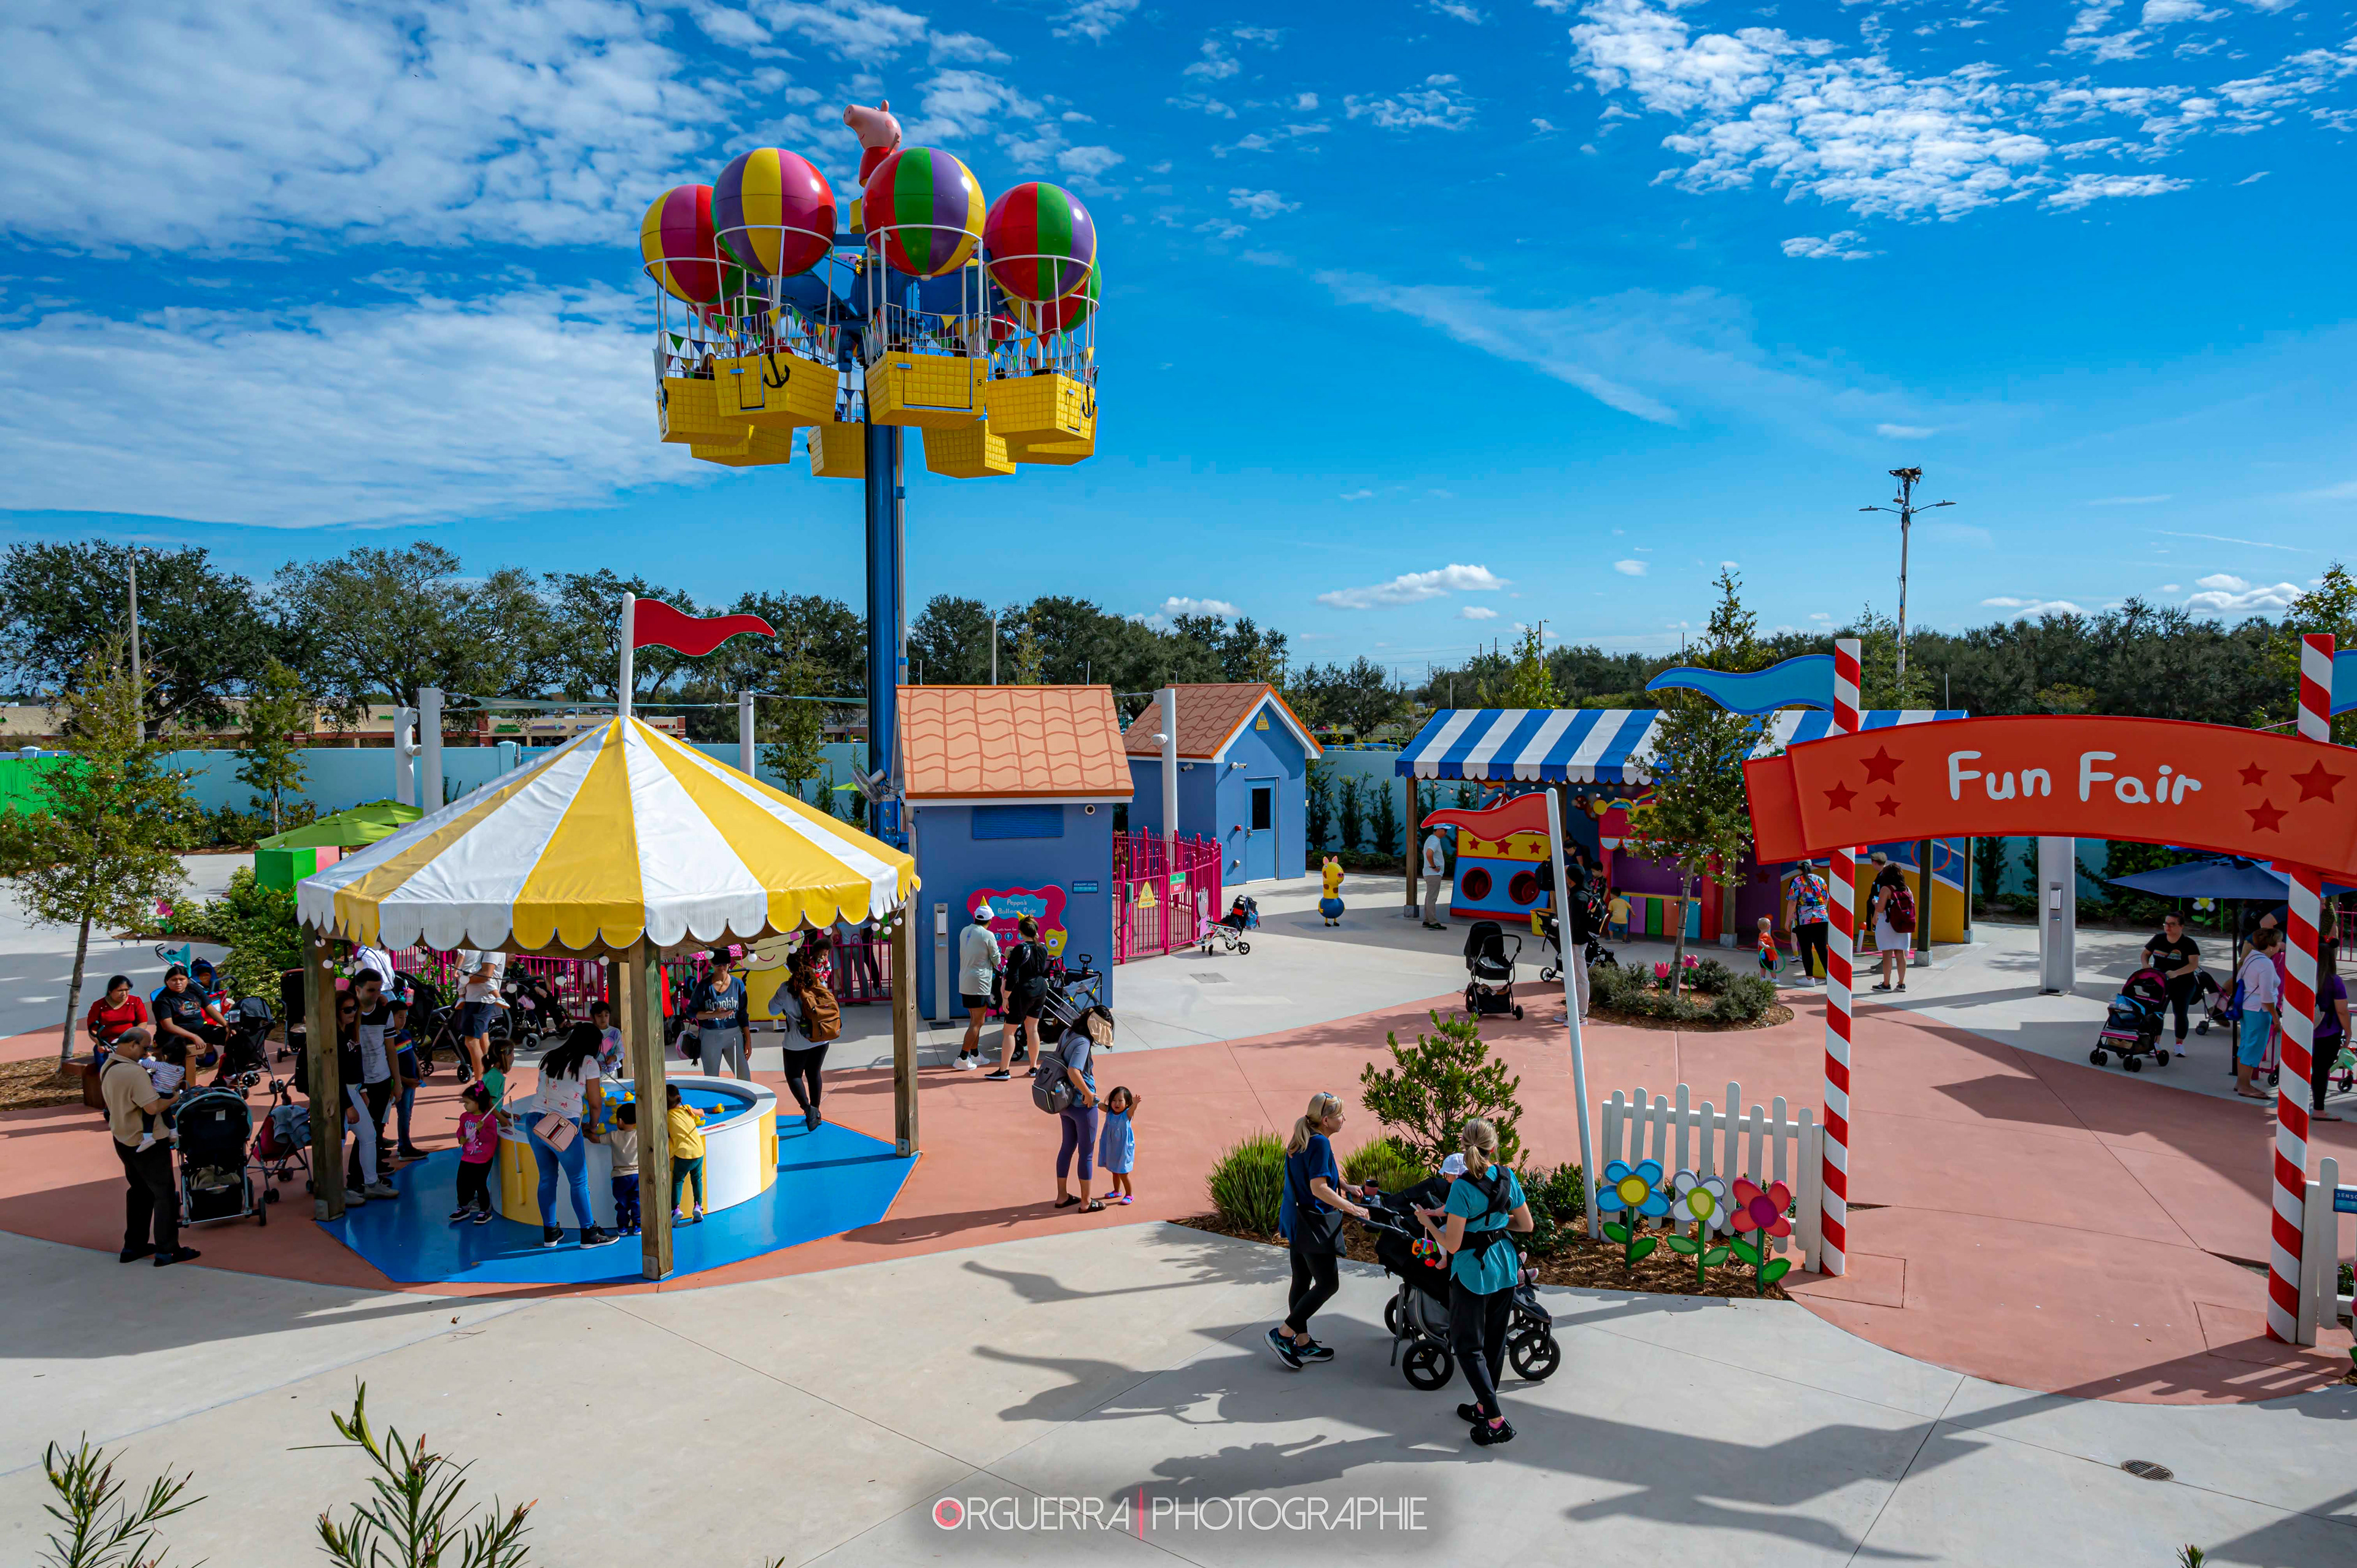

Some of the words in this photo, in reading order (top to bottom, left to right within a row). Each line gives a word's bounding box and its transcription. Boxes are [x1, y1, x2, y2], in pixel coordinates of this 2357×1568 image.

[1948, 750, 2051, 801] Fun
[2079, 751, 2202, 805] Fair
[1007, 898, 1028, 907] Peppa's
